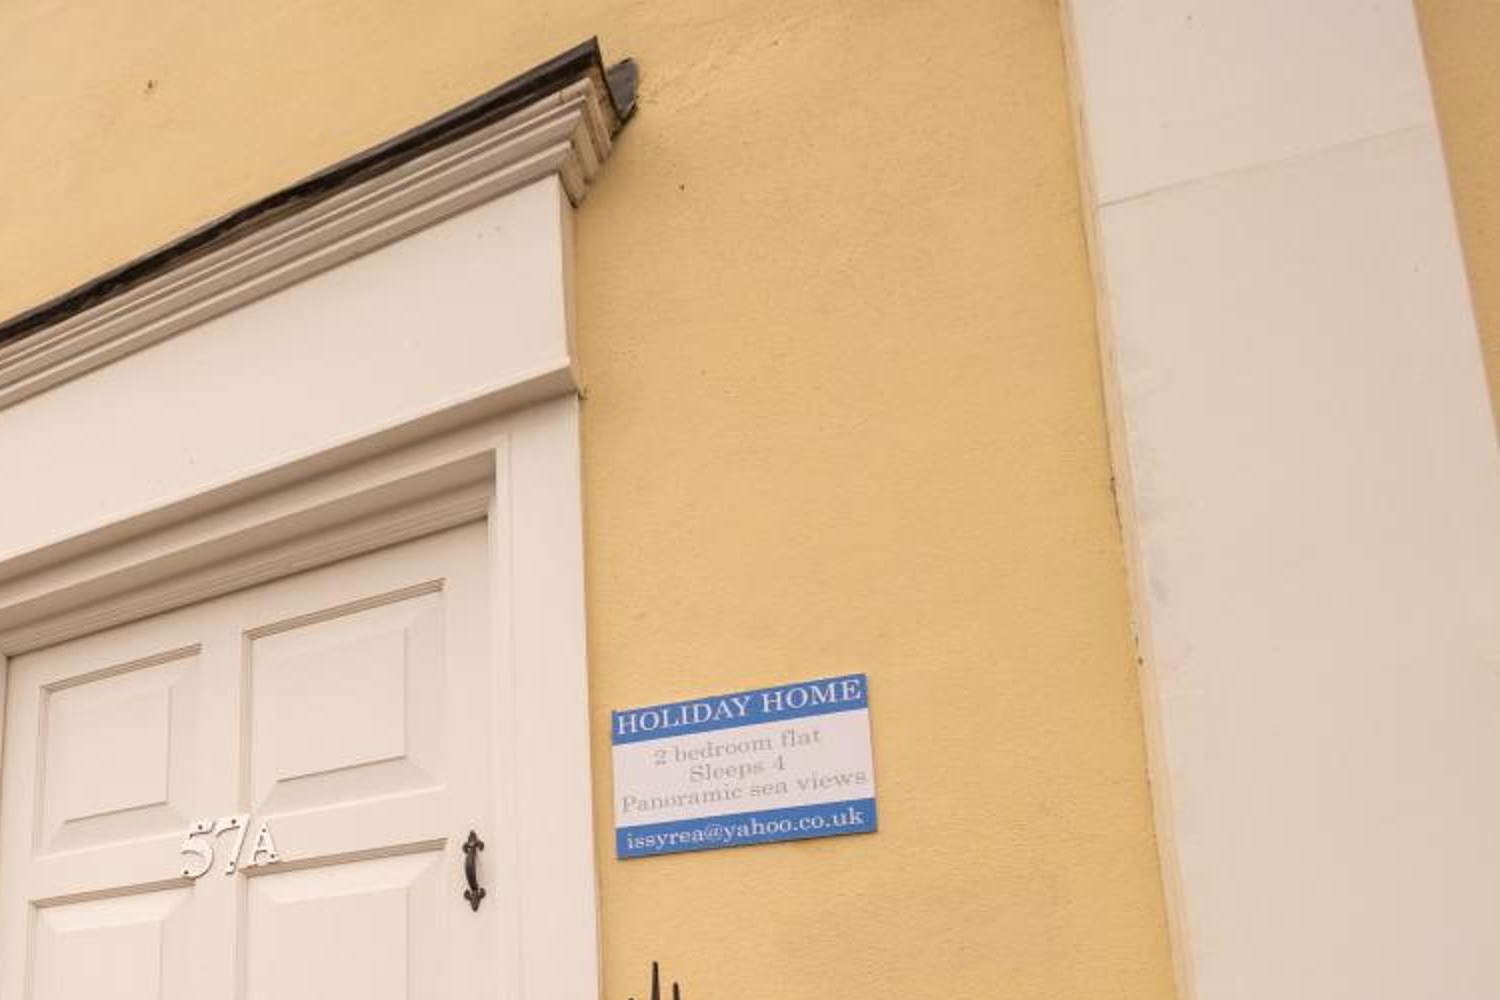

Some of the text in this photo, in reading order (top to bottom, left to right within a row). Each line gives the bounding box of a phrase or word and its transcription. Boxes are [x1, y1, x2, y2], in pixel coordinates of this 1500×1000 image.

[617, 679, 861, 735] HOLIDAY HOME
[654, 728, 821, 765] 2 bedroom flat
[689, 754, 785, 784] Sleeps 4
[621, 769, 868, 814] Panoramic sea views
[179, 814, 281, 879] 57A
[626, 807, 865, 850] issyrea@yahoo.co.uk
